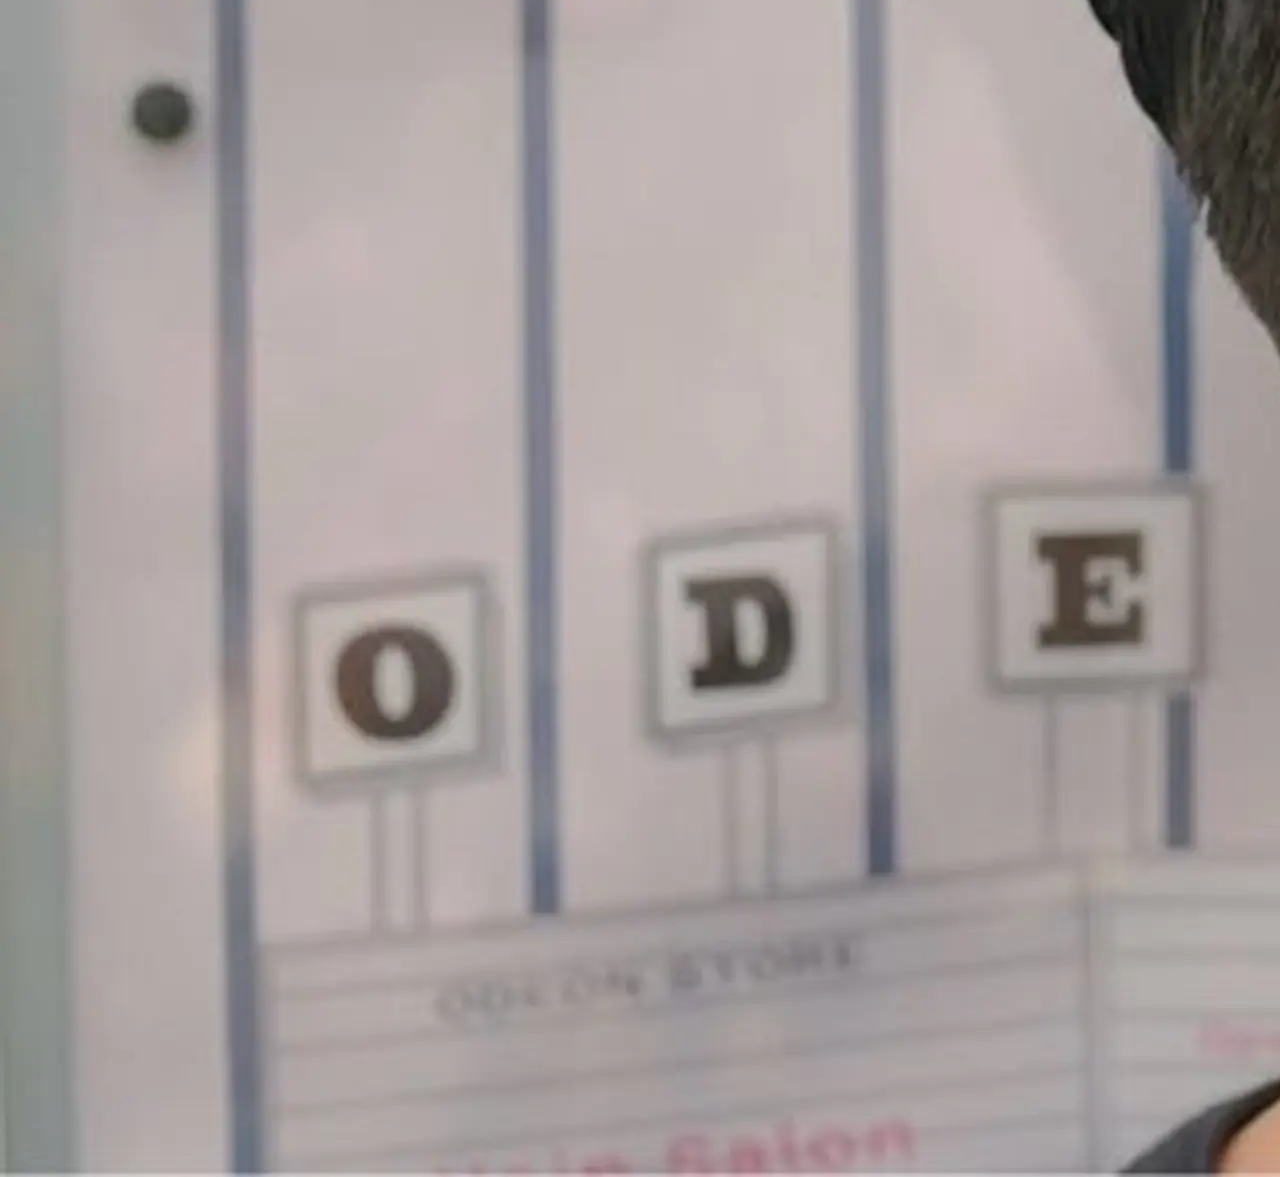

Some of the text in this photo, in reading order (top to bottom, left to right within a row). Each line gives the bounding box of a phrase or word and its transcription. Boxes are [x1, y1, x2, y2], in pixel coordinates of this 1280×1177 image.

[334, 532, 1145, 742] O D E
